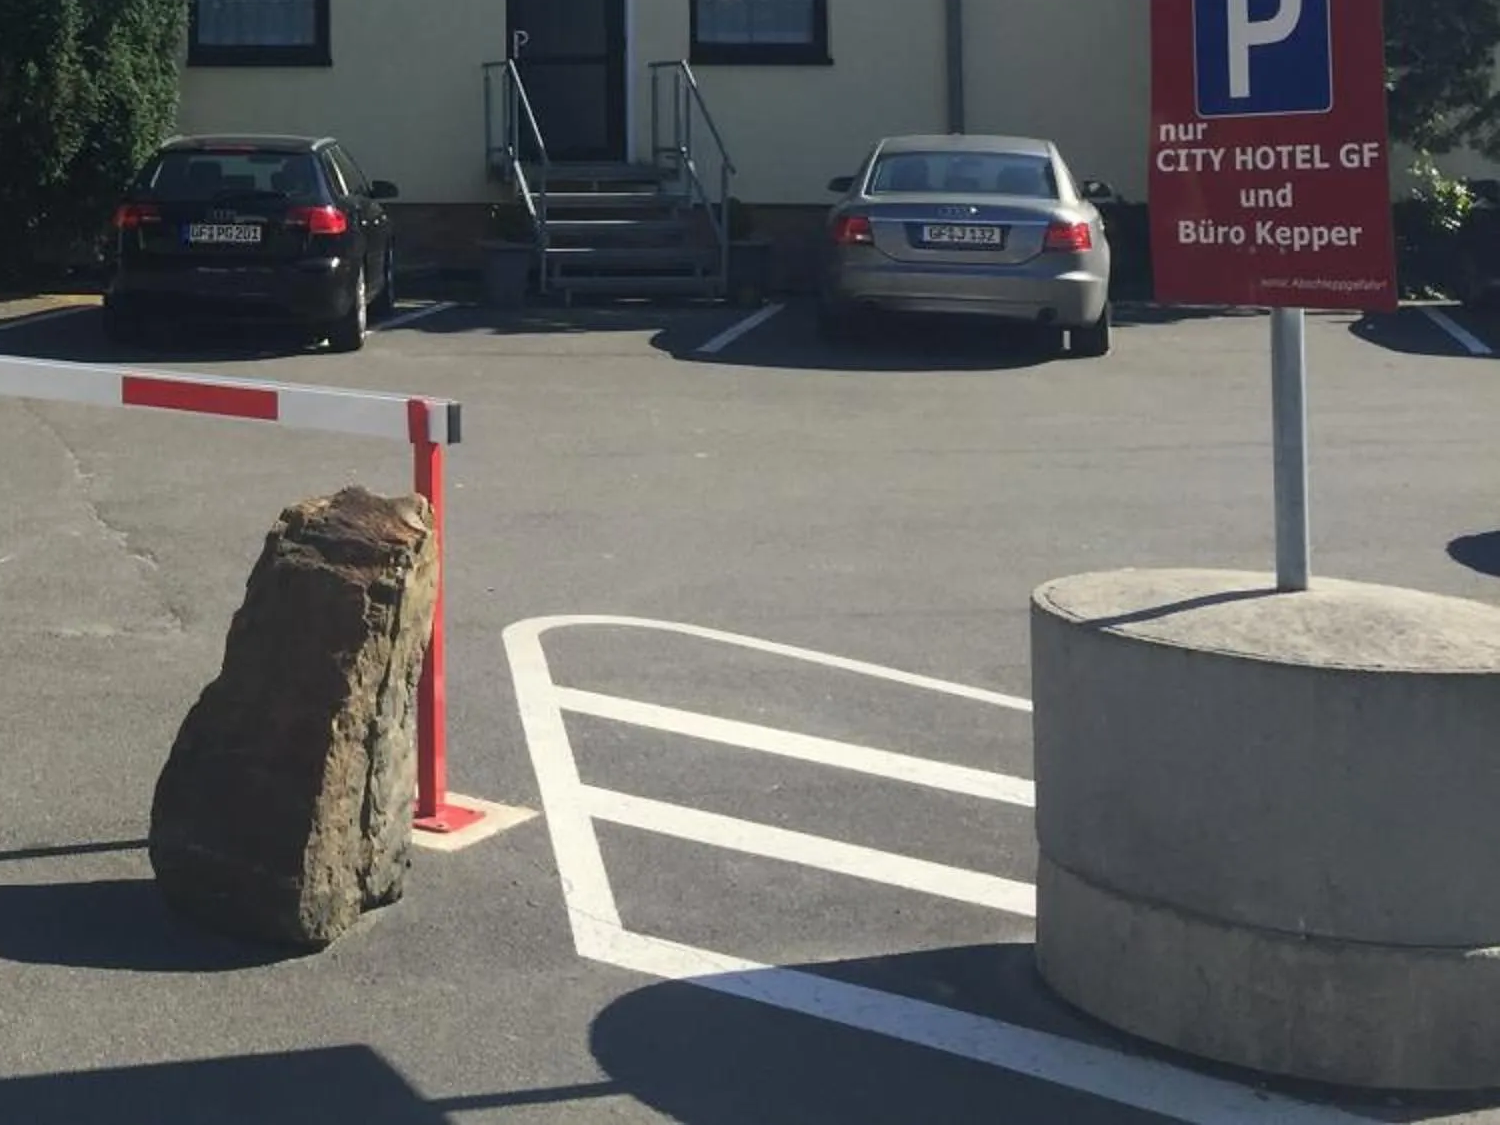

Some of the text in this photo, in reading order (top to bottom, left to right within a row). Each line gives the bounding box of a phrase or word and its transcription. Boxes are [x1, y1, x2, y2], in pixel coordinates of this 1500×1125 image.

[1159, 122, 1208, 142] nur
[1156, 142, 1380, 173] CITY HOTEL GF
[1240, 183, 1293, 208] und
[1178, 220, 1362, 252] Büro Kepper
